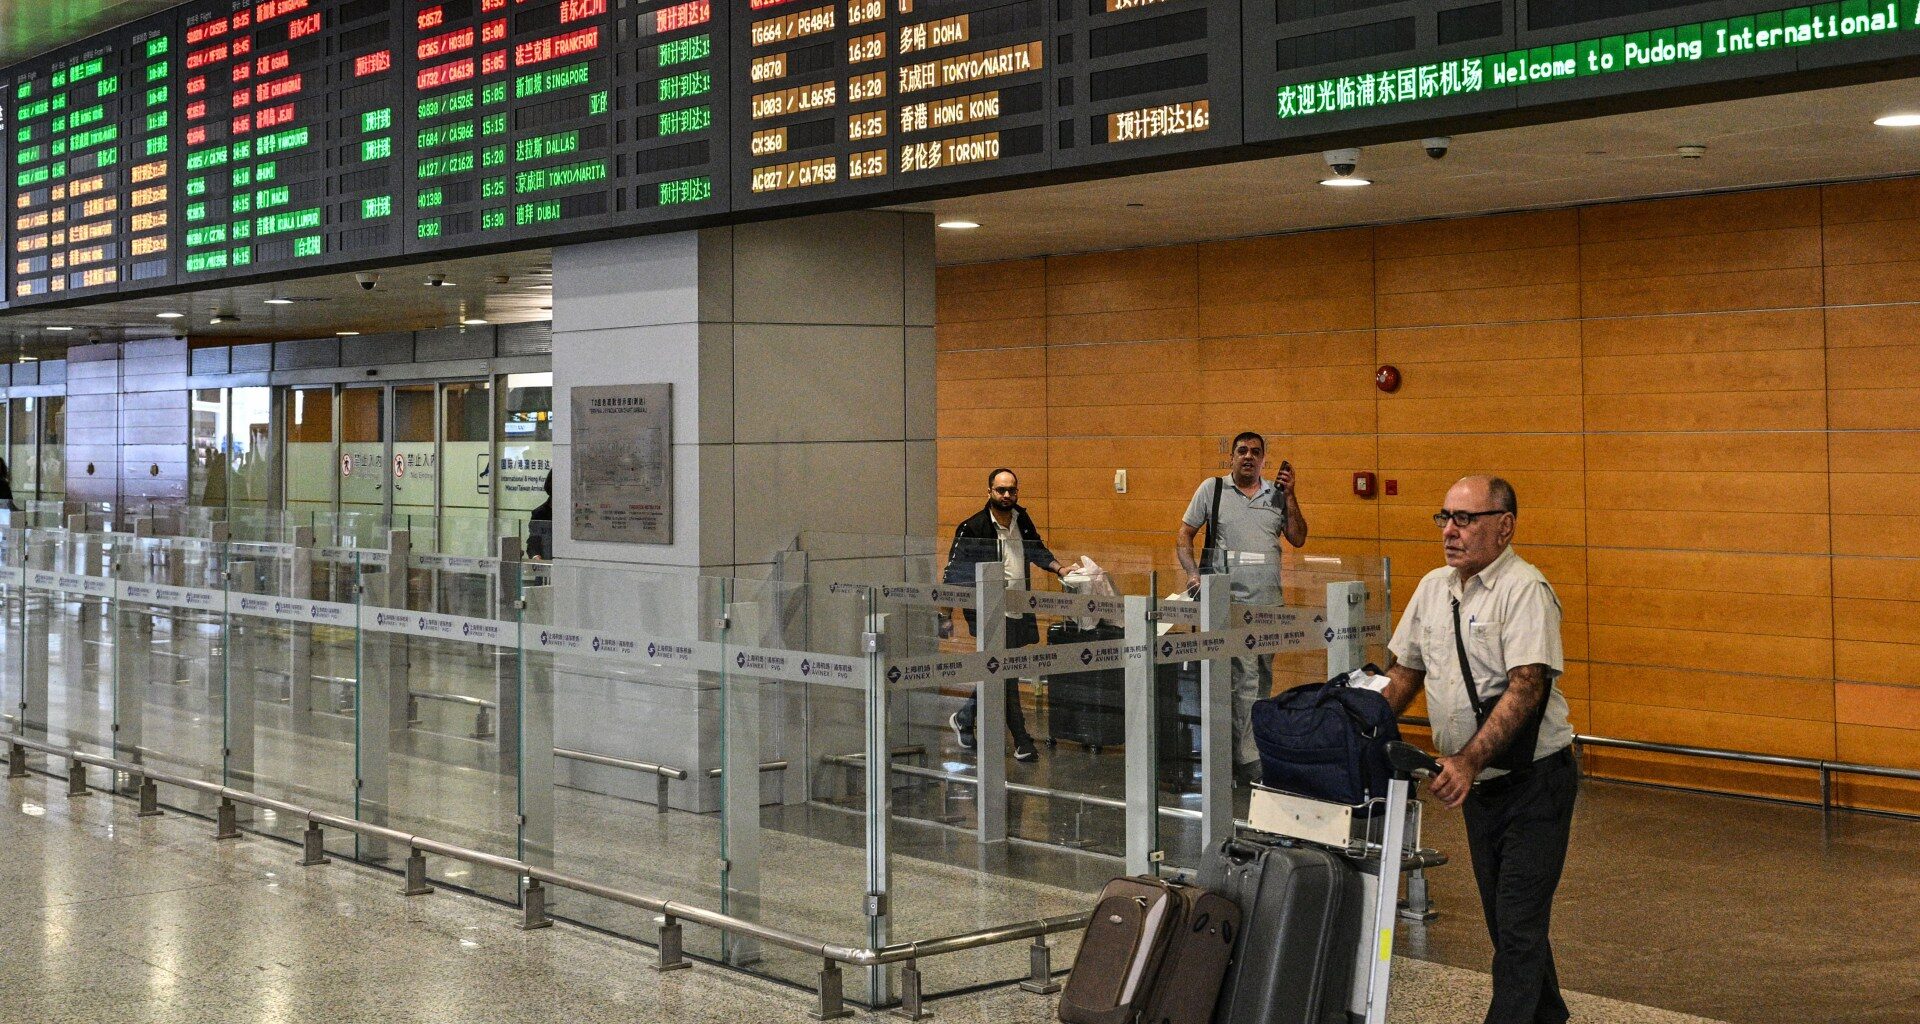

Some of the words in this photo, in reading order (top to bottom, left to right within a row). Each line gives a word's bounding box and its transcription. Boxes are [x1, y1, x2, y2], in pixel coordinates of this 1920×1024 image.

[657, 3, 710, 32] 预计到达14
[849, 1, 881, 23] 16:00
[482, 24, 504, 42] 15:00
[752, 24, 781, 43] TG664
[799, 11, 835, 34] PG4841
[900, 24, 926, 54] 多哈
[933, 23, 962, 44] DOHA
[418, 41, 439, 60] OZ365
[516, 38, 551, 66] 法兰克福
[554, 32, 597, 55] FRANKFURT
[849, 40, 881, 61] 16:20
[482, 55, 504, 75] 15:05
[943, 51, 1030, 82] TOKYO/NARITA
[1278, 58, 1482, 118] 欢迎光临浦东国际机场
[1493, 57, 1576, 84] Welcome
[1588, 51, 1613, 71] to
[1625, 40, 1702, 66] Pudong
[1717, 4, 1898, 53] International
[752, 61, 781, 80] QR870
[418, 72, 439, 90] LH732
[516, 72, 542, 98] 新加坡
[546, 68, 588, 90] SINGAPORE
[849, 79, 881, 100] 16:20
[482, 87, 504, 103] 15:05
[752, 97, 782, 117] IJ003
[799, 87, 835, 108] JL8695
[418, 102, 439, 118] SQ830
[901, 103, 928, 132] 香港
[934, 104, 963, 124] HONG
[970, 98, 999, 118] KONG
[482, 119, 504, 135] 15:15
[849, 118, 882, 138] 16:25
[1117, 104, 1208, 140] 预计到达16:
[278, 132, 308, 149] VANCOUVER
[418, 132, 438, 148] ET684
[516, 137, 542, 161] 达拉斯
[546, 136, 575, 154] DALLAS
[752, 135, 782, 153] CX360
[482, 150, 504, 166] 15:20
[901, 141, 941, 172] 多伦多
[949, 140, 999, 162] TORONTO
[418, 163, 438, 178] AA127
[549, 164, 606, 186] TOKYO/NARITA
[849, 157, 882, 176] 16:25
[752, 172, 782, 190] AC027
[800, 164, 836, 183] CA7458
[482, 181, 504, 198] 15:25
[418, 192, 442, 207] HO1380
[482, 213, 504, 229] 15:30
[516, 204, 534, 225] 迪拜
[537, 204, 560, 221] DUBAI
[418, 223, 439, 238] EK302
[1176, 640, 1198, 648] 上海机场
[1202, 638, 1225, 646] 浦东机场
[1258, 633, 1280, 642] 上海机场
[1283, 631, 1305, 639] 浦东机场
[1258, 640, 1280, 648] AVINEX
[1002, 655, 1028, 665] 上海机场
[1032, 653, 1058, 662] 浦东机场
[1096, 647, 1119, 656] 上海机场
[1123, 645, 1148, 653] 浦东机场
[1096, 654, 1119, 662] AVINEX
[1175, 647, 1198, 655] AVINEX
[904, 664, 931, 674] 上海机场
[936, 661, 963, 671] 浦东机场
[904, 672, 931, 680] AVINEX
[1002, 663, 1028, 671] AVINEX
